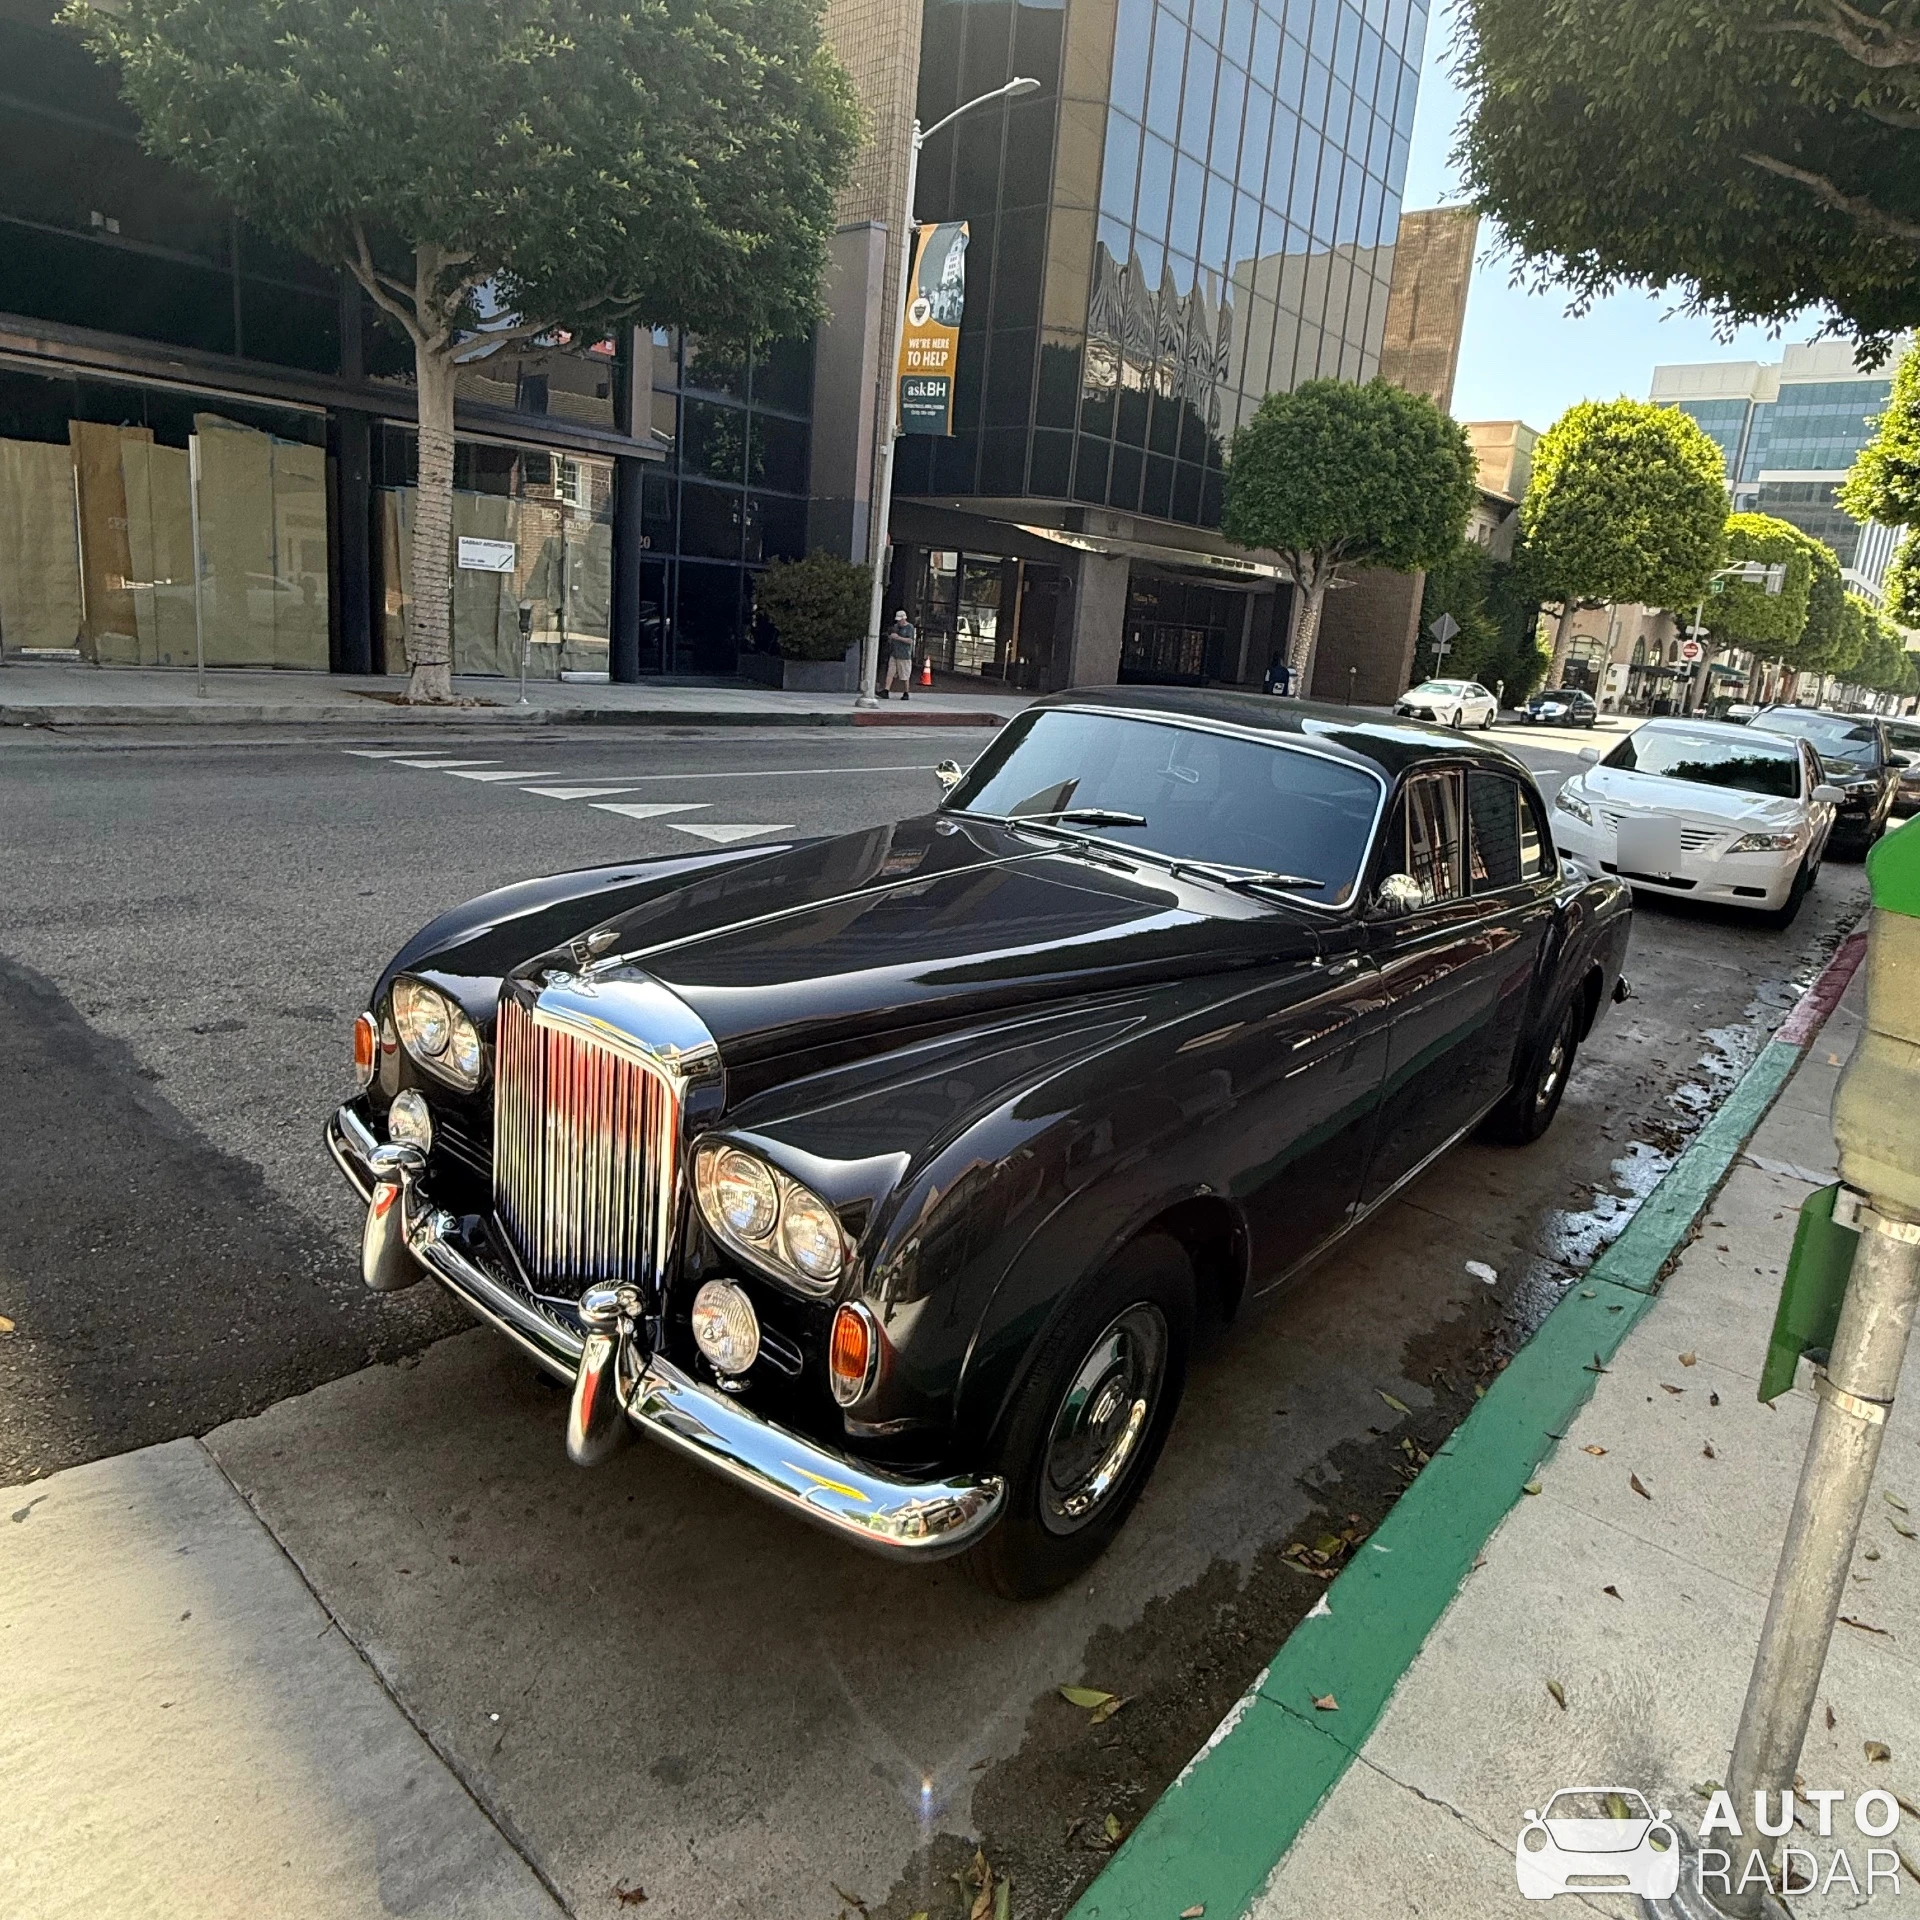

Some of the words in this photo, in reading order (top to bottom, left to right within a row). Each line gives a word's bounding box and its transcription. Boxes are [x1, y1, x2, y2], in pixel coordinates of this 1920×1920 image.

[909, 338, 931, 349] WE'RE
[932, 338, 950, 349] HERE
[907, 351, 921, 367] TO
[922, 351, 949, 367] HELP
[907, 381, 946, 397] askBH
